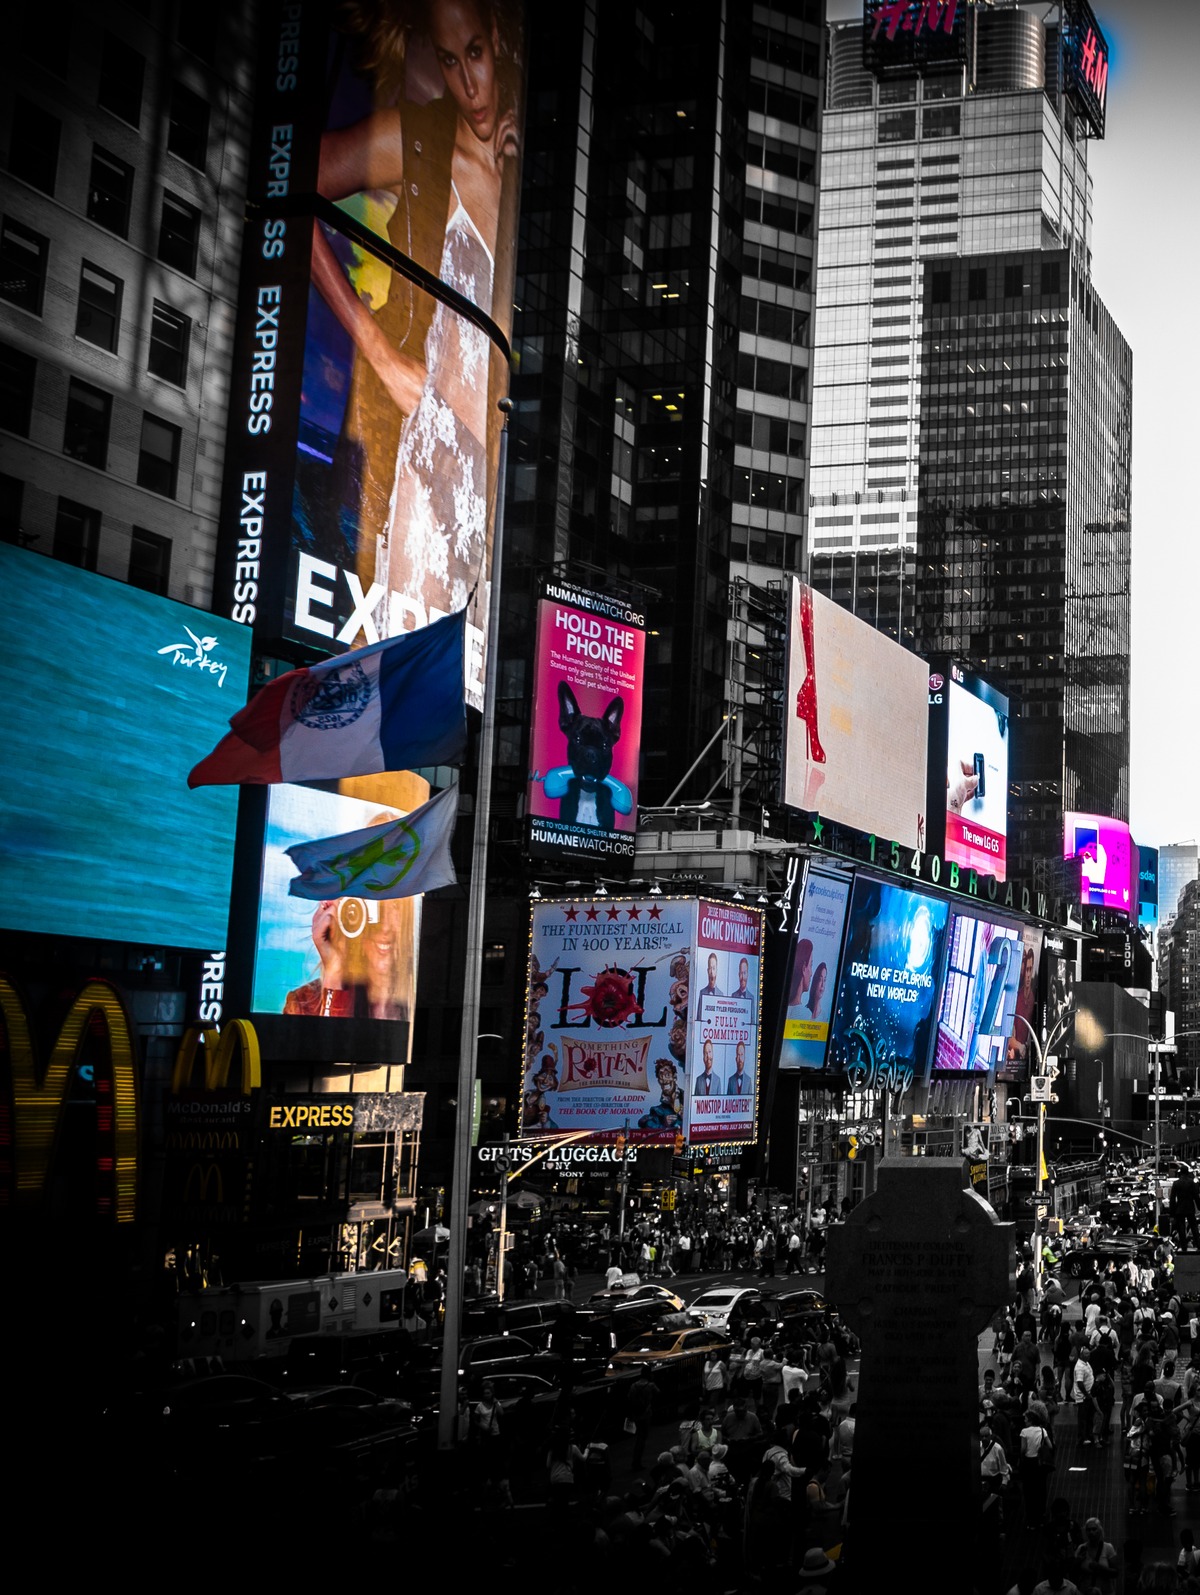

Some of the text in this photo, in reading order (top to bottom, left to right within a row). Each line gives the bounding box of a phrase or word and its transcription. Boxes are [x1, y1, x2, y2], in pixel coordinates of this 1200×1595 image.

[1081, 27, 1108, 110] H&M
[262, 124, 293, 260] EXPRSS
[247, 284, 282, 436] EXPRESS
[231, 471, 267, 624] EXPRESS
[546, 584, 646, 626] HUMANEWATCH.ORG
[555, 609, 634, 650] HOLD THE
[566, 633, 623, 666] PHONE
[157, 641, 228, 688] Turkey
[550, 650, 636, 681] The Humane Society the United
[550, 660, 635, 690] States only gives millions
[956, 667, 964, 683] LG
[574, 676, 586, 685] local
[586, 680, 596, 688] pet
[597, 681, 619, 694] shelters?
[928, 694, 943, 705] LG
[532, 819, 545, 828] GIVE
[546, 821, 554, 829] TO
[554, 823, 569, 831] YOUR
[569, 825, 586, 834] LOCAL
[531, 829, 635, 857] HUMANEWATCH.ORG
[962, 825, 1000, 853] The new LG G5
[868, 833, 940, 883] 1540
[815, 886, 846, 903] coolsculpting
[719, 908, 730, 920] TYLER
[542, 922, 684, 937] THE FUNNIEST MUSICAL
[701, 917, 724, 940] COMIC
[562, 937, 579, 951] IN
[582, 937, 610, 951] 400
[1124, 933, 1132, 968] 1500
[851, 961, 932, 988] DREAM OF EXPLORING
[866, 982, 886, 999] NEW
[714, 1016, 738, 1028] FULLY
[573, 1040, 640, 1051] SOMETHING
[702, 1028, 749, 1041] COMMITTED
[167, 1101, 252, 1114] McDonald's
[269, 1105, 354, 1129] EXPRESS
[709, 1145, 743, 1157] LUGGAGE
[862, 1253, 974, 1266] FRANCIS DUFFY
